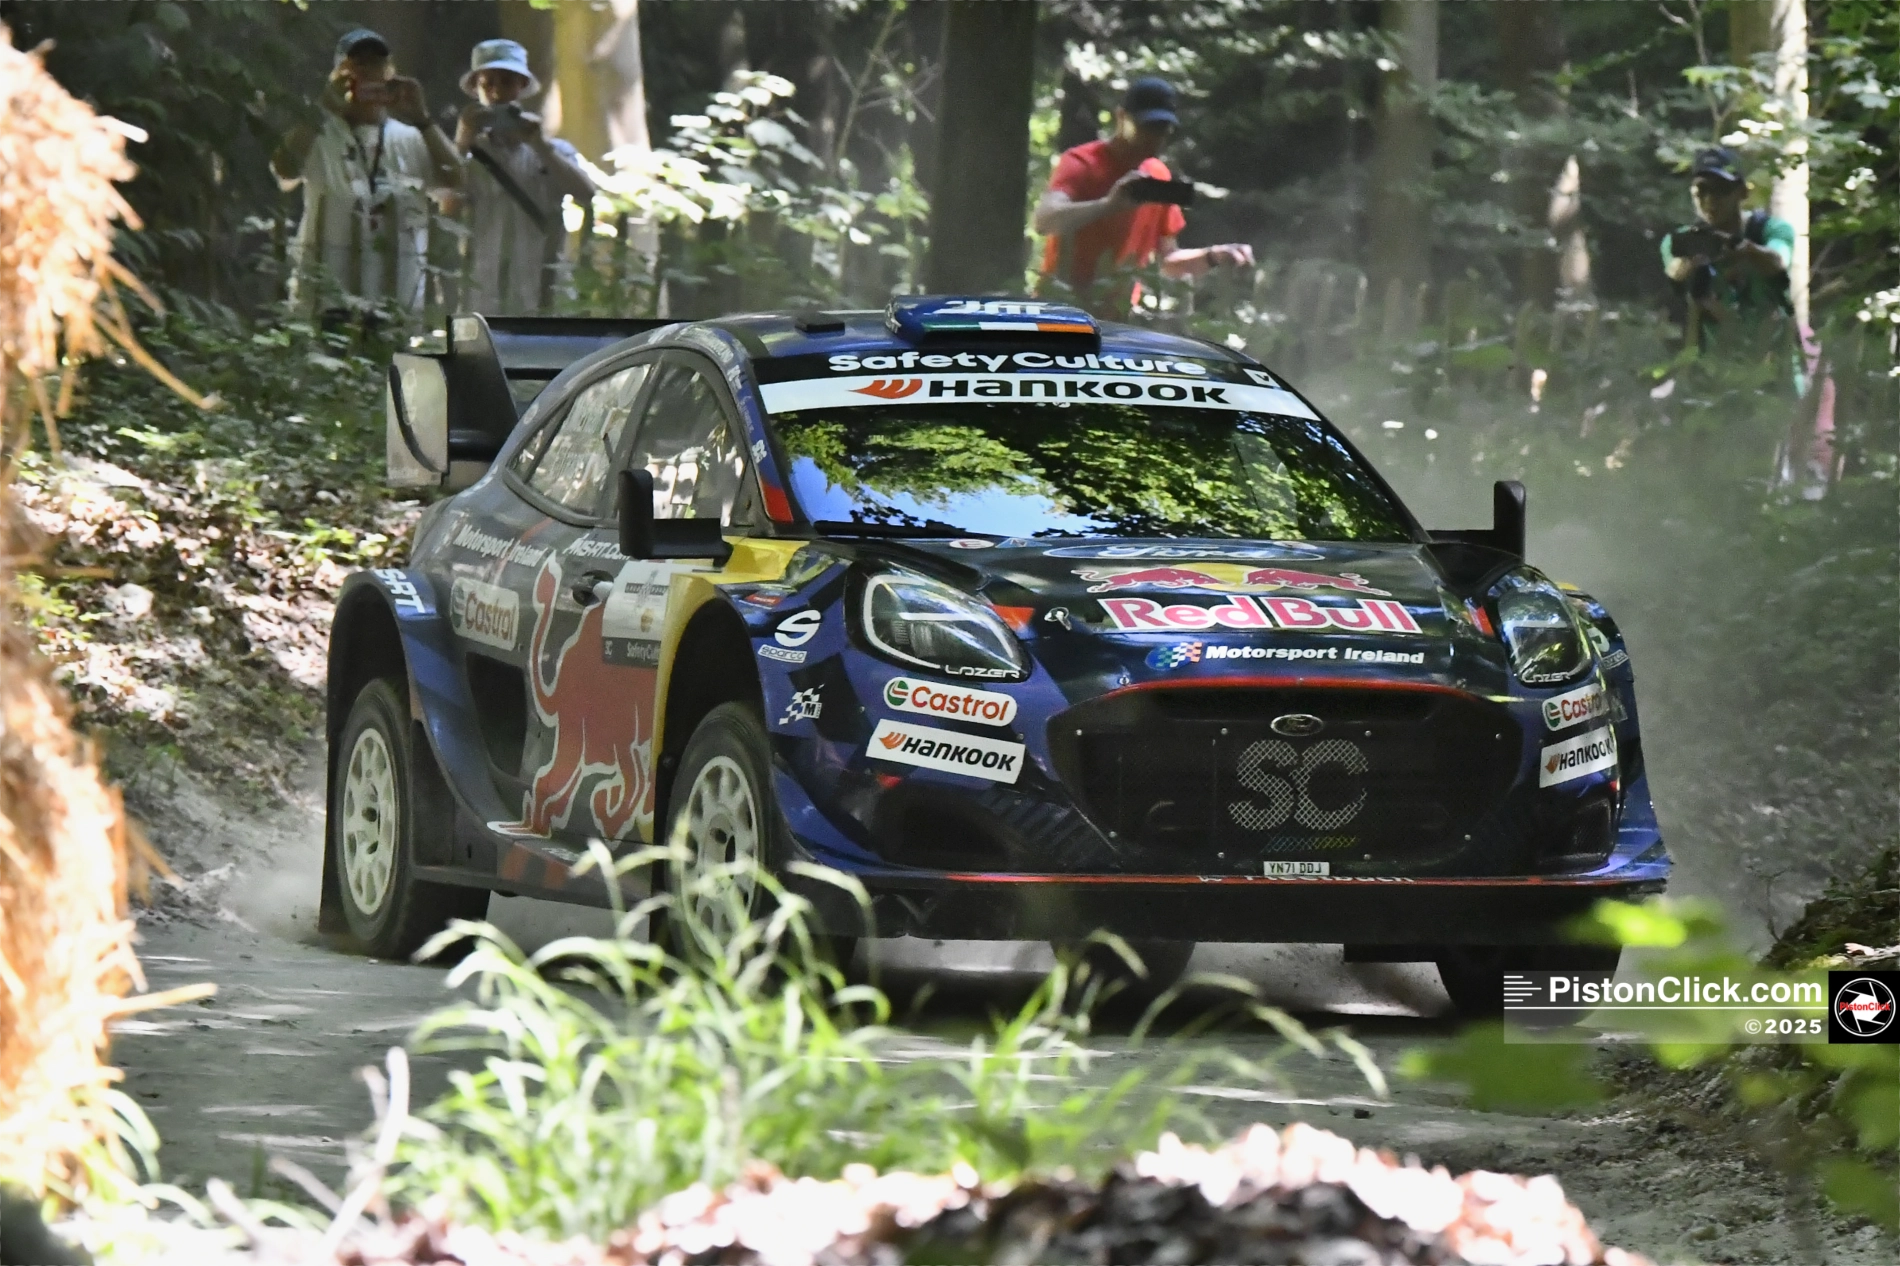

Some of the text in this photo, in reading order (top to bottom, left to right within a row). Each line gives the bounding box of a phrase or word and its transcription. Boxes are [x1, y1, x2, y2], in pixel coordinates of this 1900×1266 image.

[829, 351, 1207, 375] SafetyCulture
[453, 523, 549, 567] Motorsport Ireland
[1098, 544, 1276, 558] Ford
[465, 591, 517, 641] Castrol
[1098, 595, 1422, 633] Red Bull
[761, 646, 805, 660] sparco
[1205, 645, 1425, 664] Motorsport Ireland
[945, 664, 1020, 679] LAZER
[911, 686, 1010, 721] Castrol
[1228, 739, 1369, 831] SC
[1268, 862, 1322, 873] YN71 DDJ
